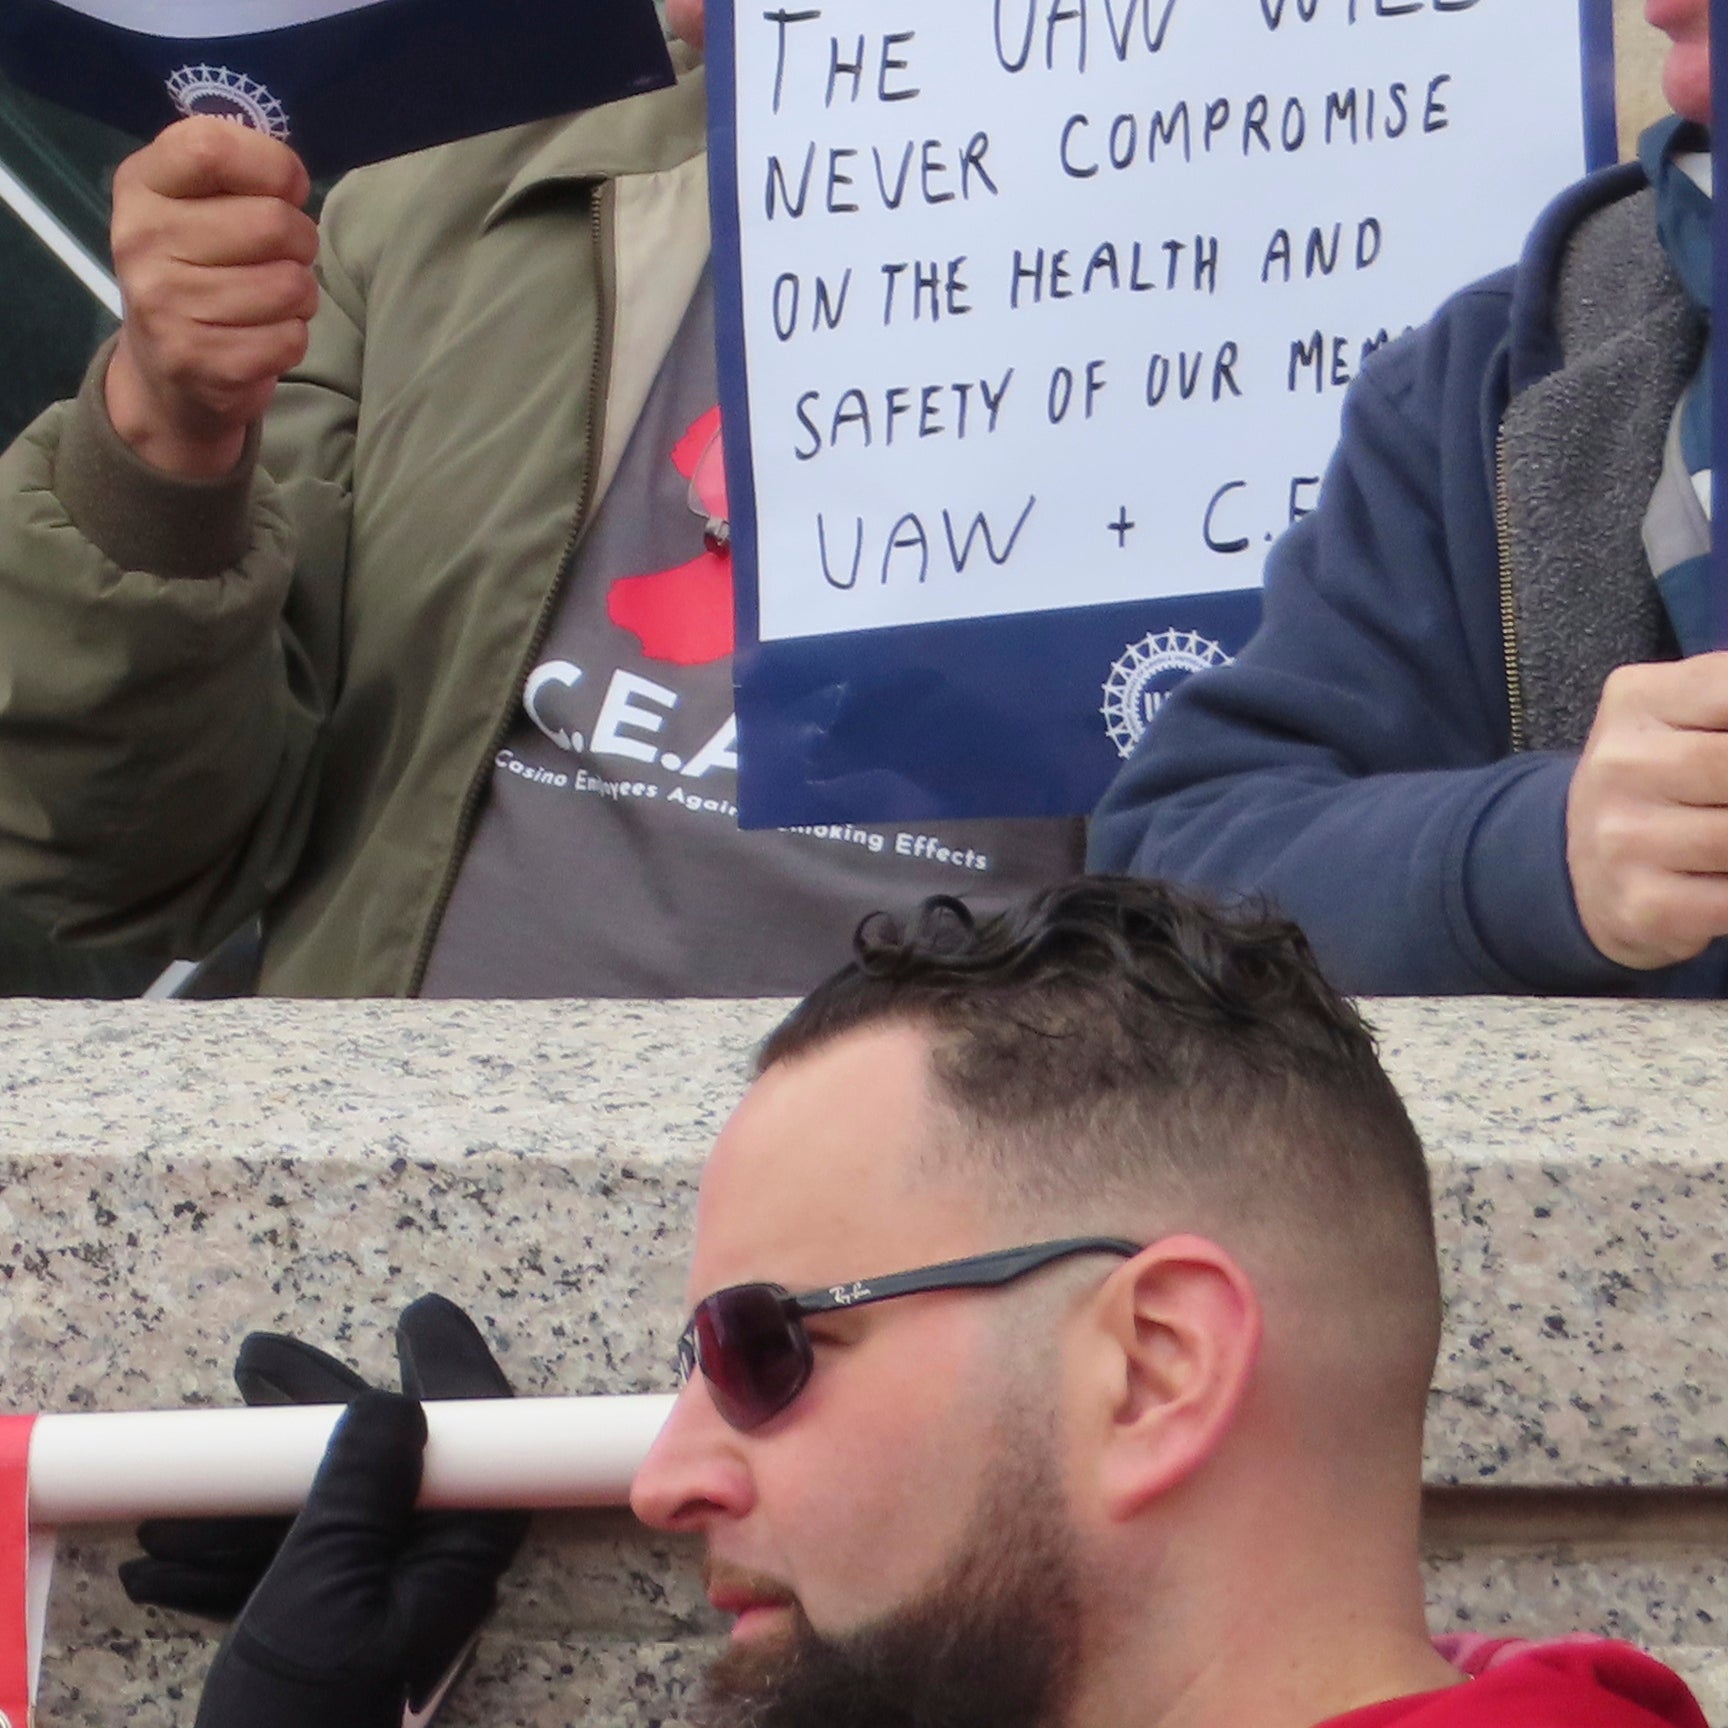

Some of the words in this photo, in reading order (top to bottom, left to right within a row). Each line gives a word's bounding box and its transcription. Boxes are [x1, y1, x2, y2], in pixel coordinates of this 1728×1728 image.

[762, 5, 922, 115] THE
[762, 128, 998, 222] NEVER
[1059, 72, 1453, 180] COMPROMISE
[771, 270, 852, 342] ON
[881, 255, 972, 325] THE
[1010, 236, 1220, 311] HEALTH
[1260, 215, 1384, 289] AND
[793, 365, 1017, 461] SAFETY
[1046, 357, 1109, 425] OF
[1145, 338, 1242, 408] OUR
[816, 494, 1036, 592] UAW
[494, 749, 568, 788] Casino
[778, 823, 885, 852] oking
[896, 832, 988, 871] Effects
